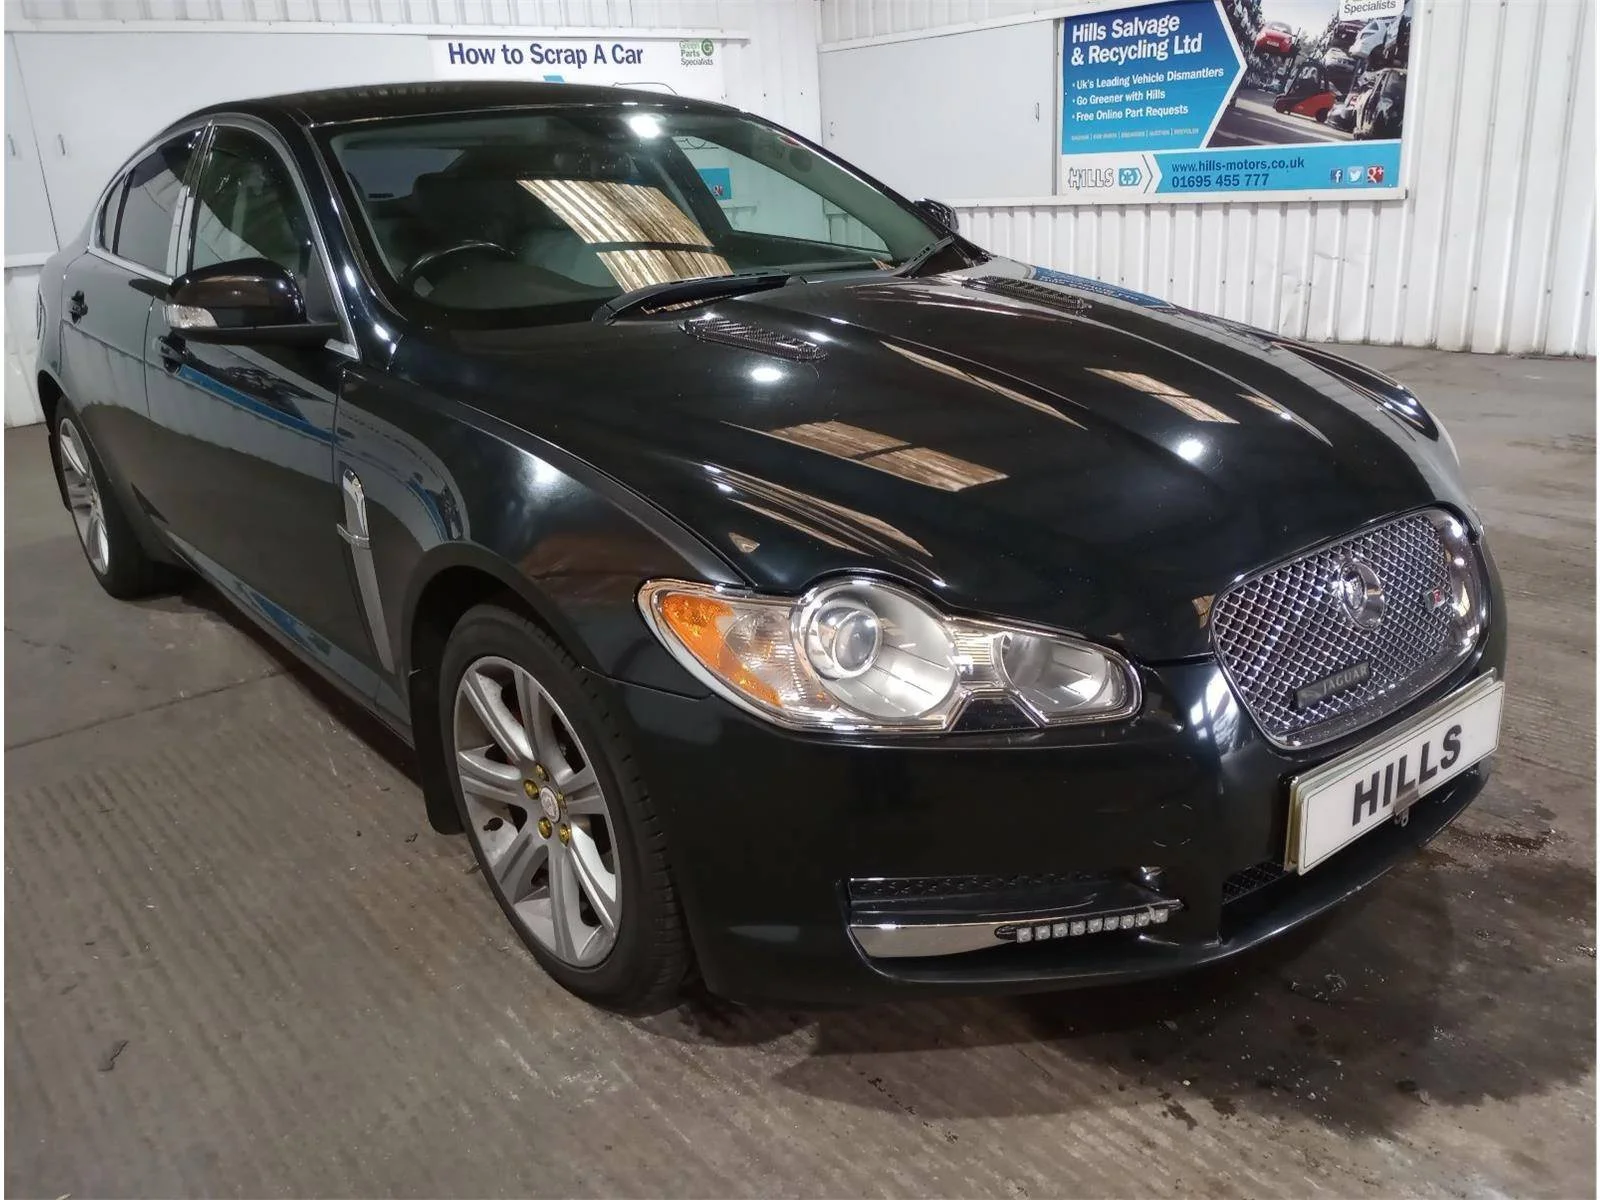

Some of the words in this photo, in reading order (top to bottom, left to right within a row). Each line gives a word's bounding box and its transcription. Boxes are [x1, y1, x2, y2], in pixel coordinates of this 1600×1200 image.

[1344, 0, 1397, 15] Specialists
[1072, 22, 1107, 43] Hills
[1111, 14, 1180, 38] Salvage
[448, 42, 496, 65] How
[501, 44, 524, 65] to
[529, 43, 588, 69] Scrap
[593, 43, 608, 64] A
[611, 44, 644, 65] Car
[680, 49, 701, 58] Parts
[1071, 46, 1085, 67] &
[1088, 38, 1170, 66] Recycling
[1173, 33, 1203, 56] Ltd
[680, 57, 714, 67] Specialists
[1096, 76, 1130, 88] Leading
[1132, 72, 1165, 85] Vehicle
[1167, 67, 1224, 82] Dismantlers
[1076, 95, 1088, 106] Go
[1089, 93, 1123, 105] Greener
[1125, 90, 1143, 101] with
[1146, 89, 1166, 100] Hills
[1076, 111, 1094, 122] Free
[1096, 108, 1123, 120] Online
[1125, 107, 1143, 118] Part
[1145, 104, 1189, 117] Requests
[1171, 157, 1305, 173] www.hills-motors.co.uk
[1068, 167, 1115, 190] HILLS
[1171, 174, 1212, 188] 01695
[1215, 173, 1240, 187] 455
[1244, 173, 1270, 187] 777
[1322, 665, 1367, 696] JAGUAR
[1352, 724, 1463, 826] HILLS
